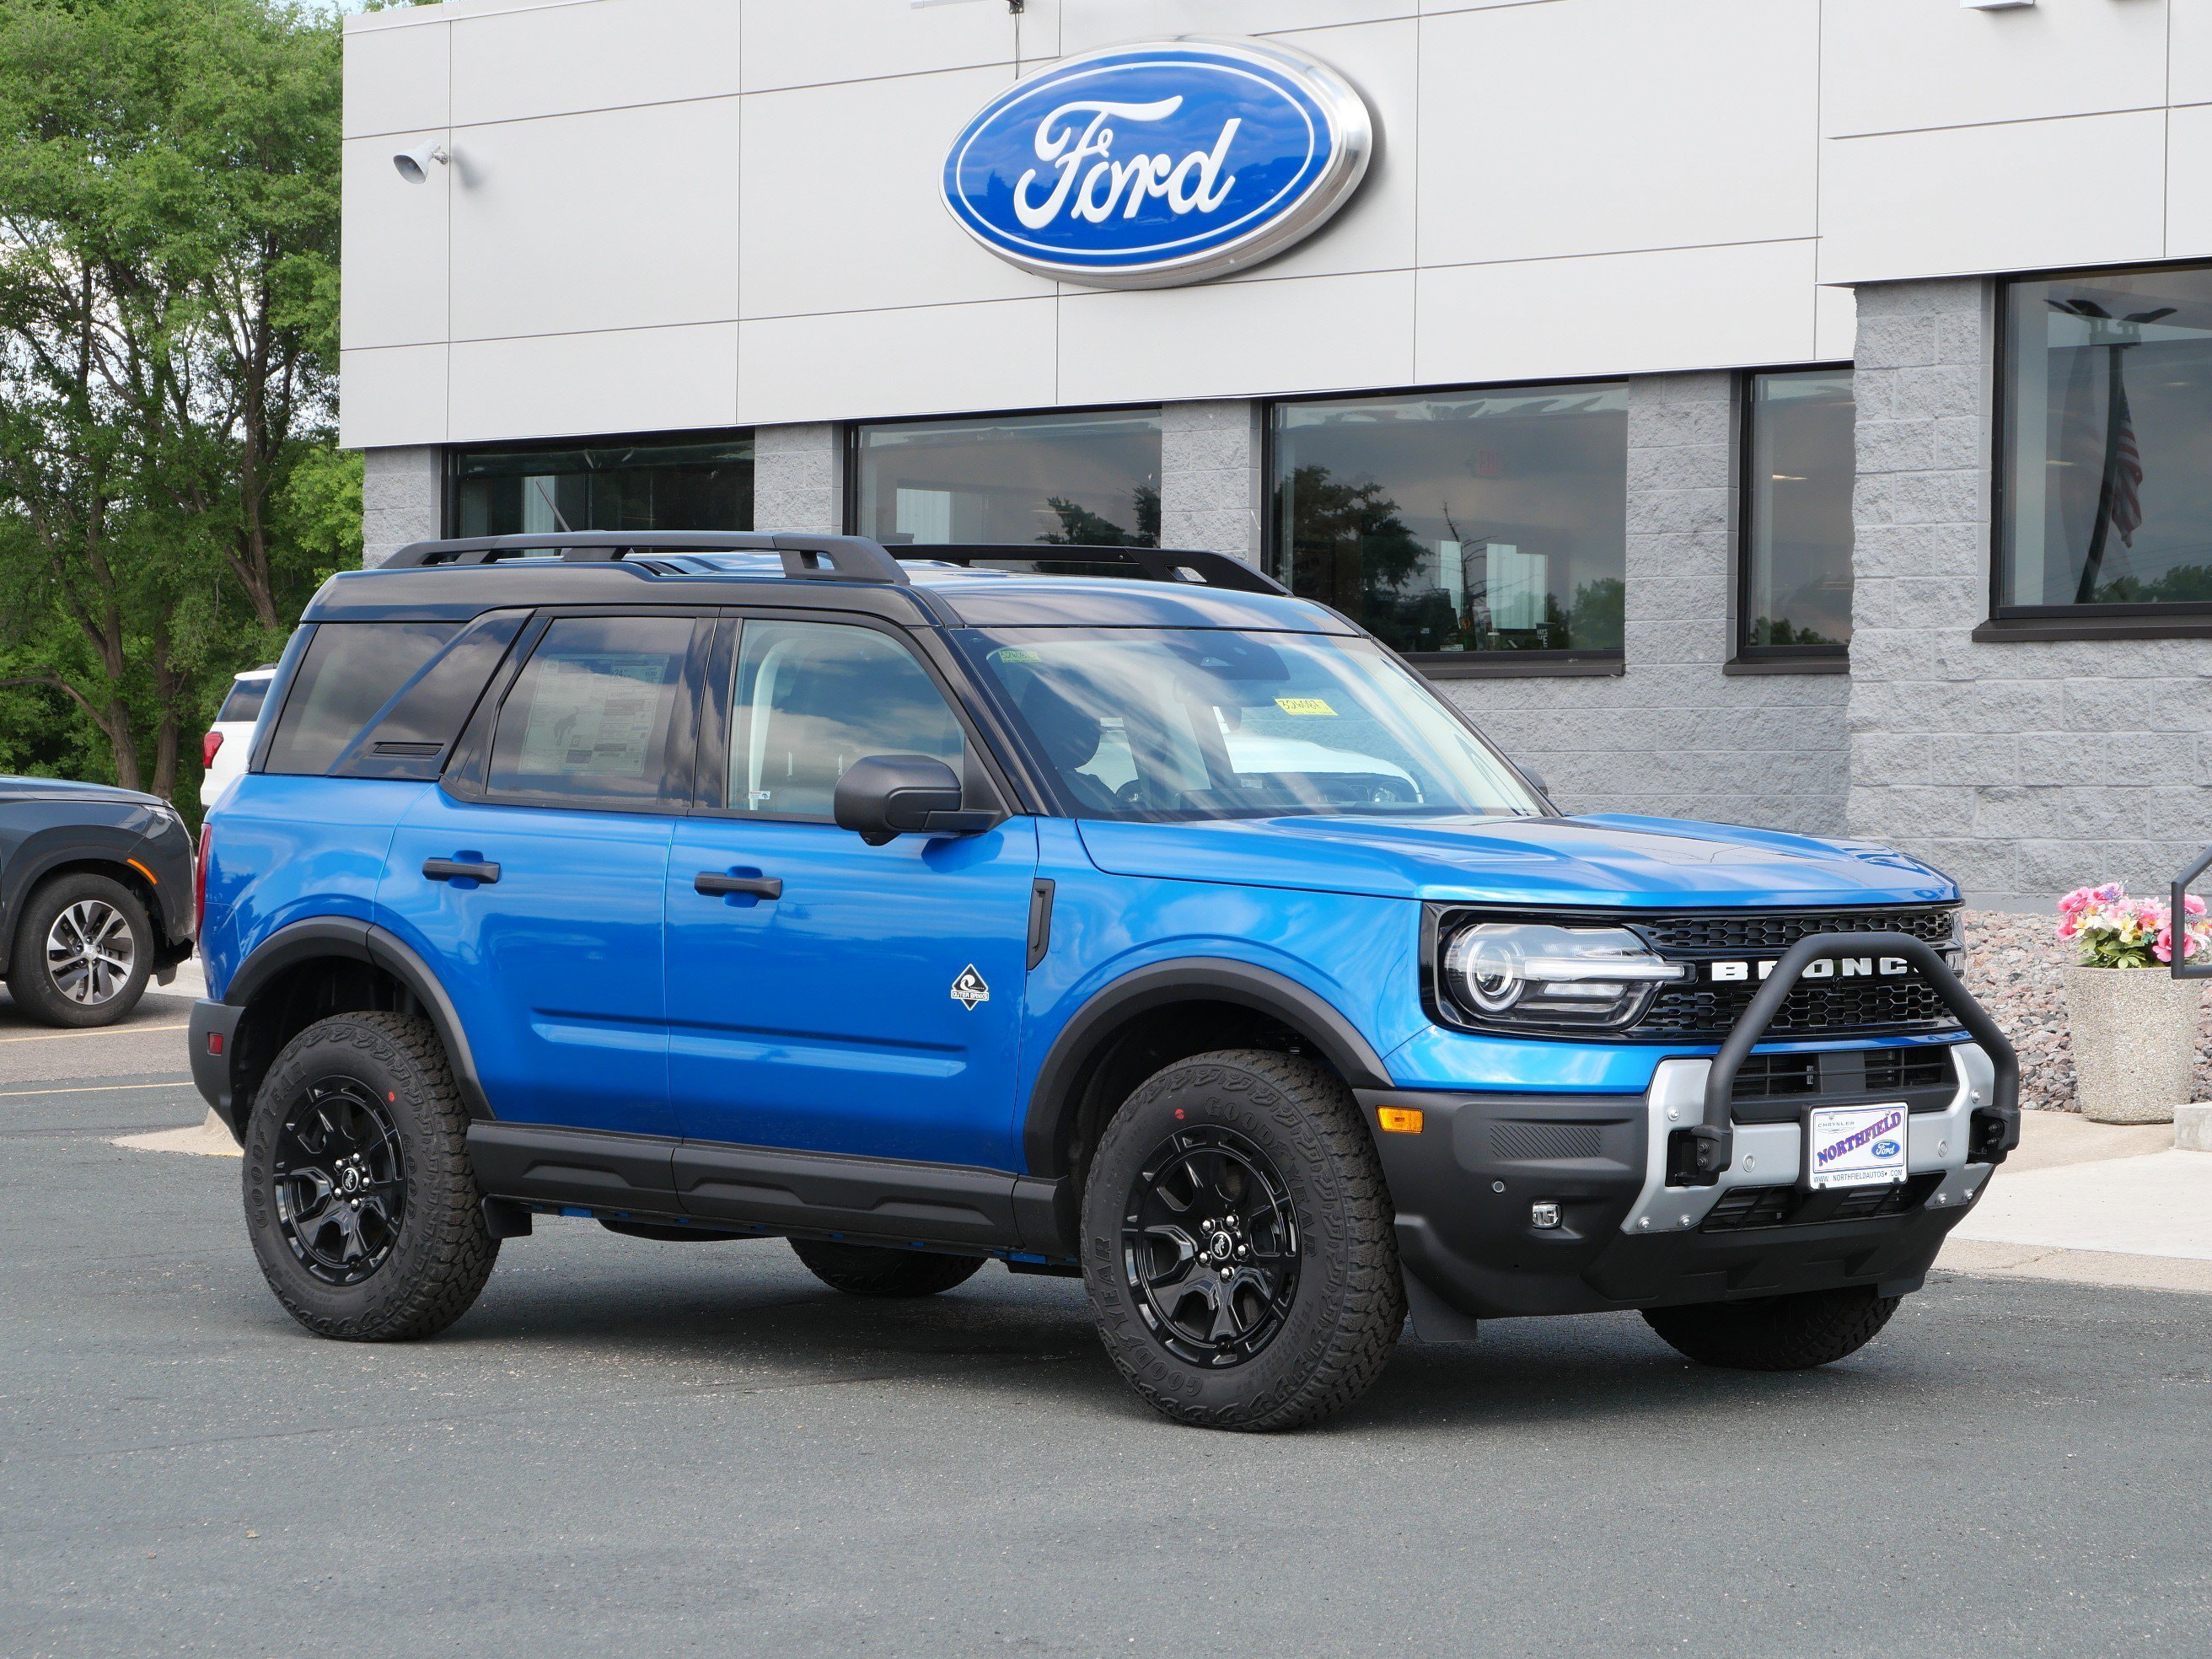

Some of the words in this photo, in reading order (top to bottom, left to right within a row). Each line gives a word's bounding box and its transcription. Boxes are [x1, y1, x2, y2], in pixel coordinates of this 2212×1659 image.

[1013, 94, 1242, 230] Ford
[1711, 957, 1919, 981] BONC
[1203, 1094, 1319, 1258] GOODYEAR
[1817, 1111, 1902, 1167] NORTHFIELD
[1876, 1141, 1896, 1155] Ford
[1094, 1234, 1204, 1399] GOODYEAR
